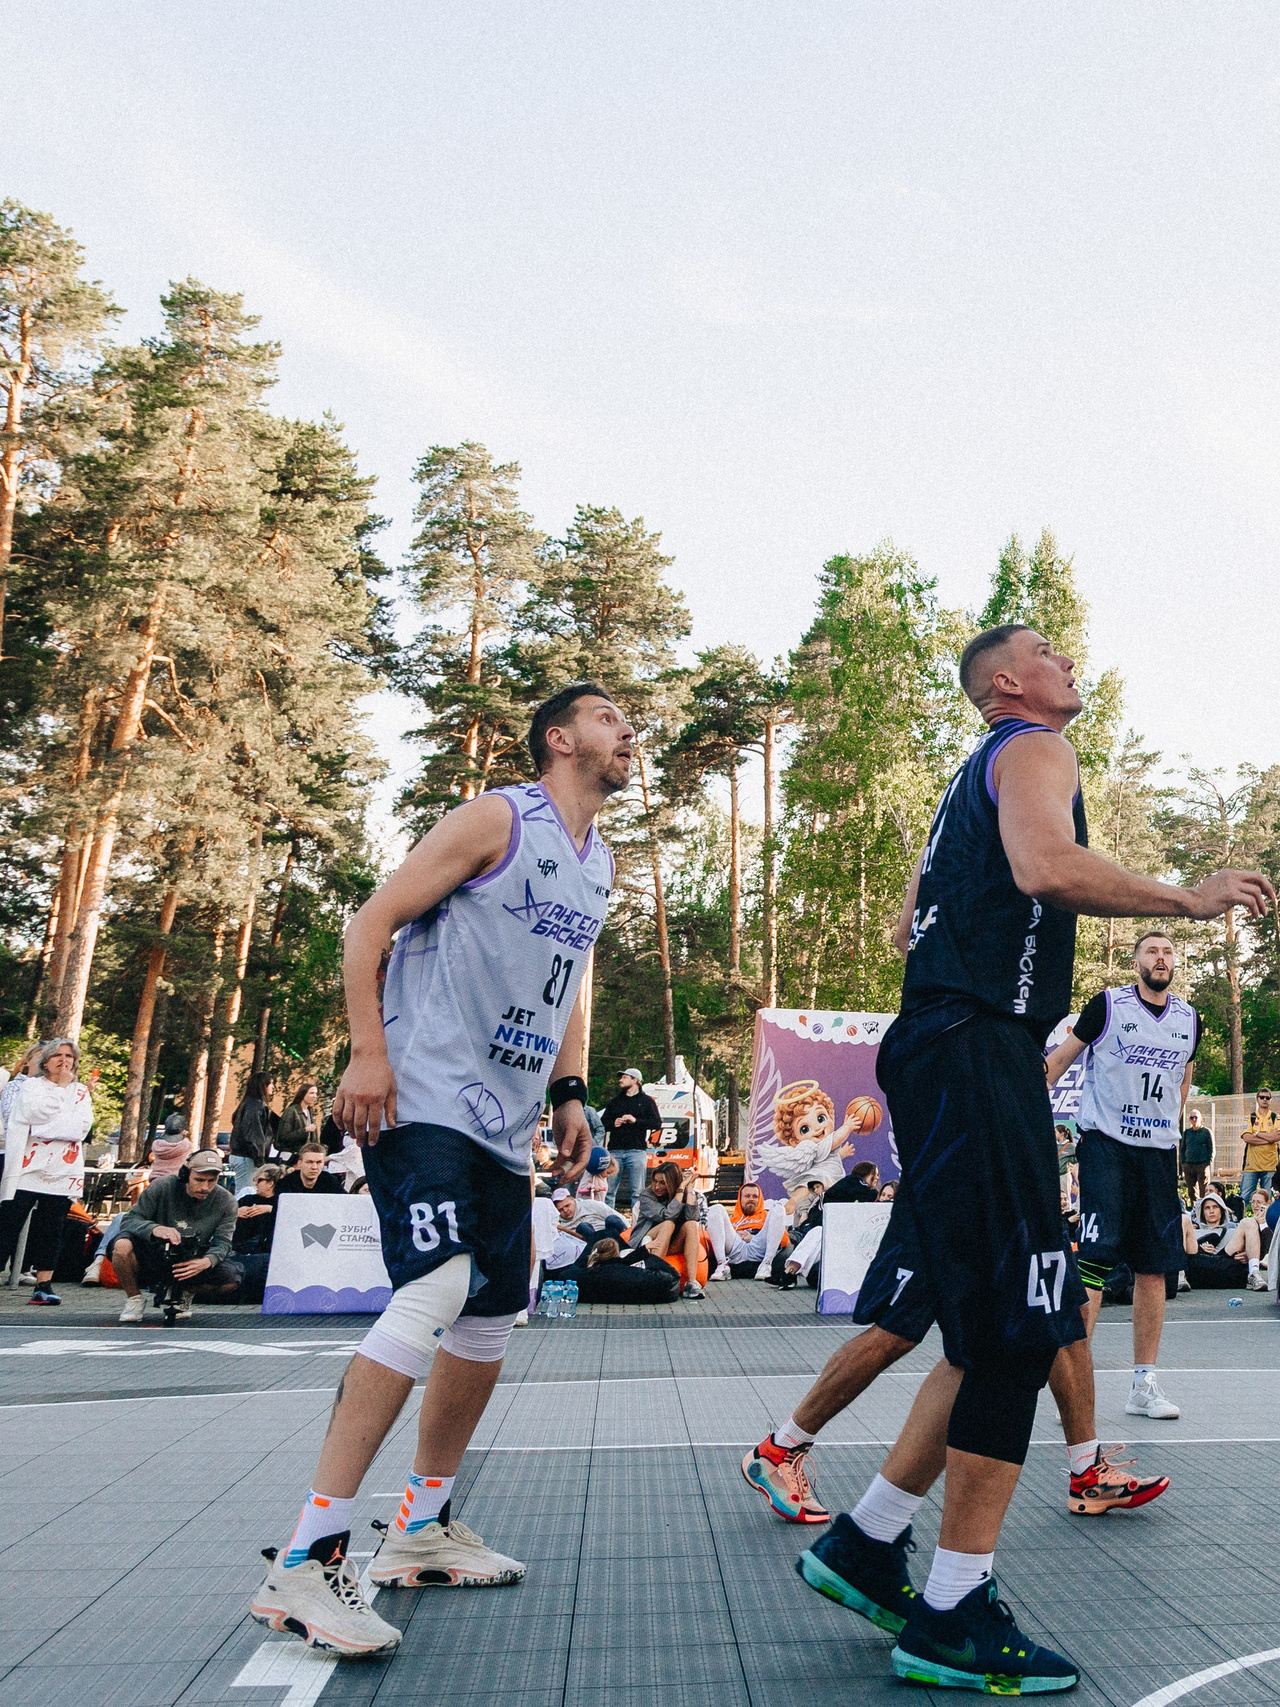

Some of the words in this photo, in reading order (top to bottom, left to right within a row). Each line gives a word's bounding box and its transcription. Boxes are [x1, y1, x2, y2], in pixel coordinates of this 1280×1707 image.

[542, 954, 574, 1008] 81
[502, 1006, 536, 1026] JET
[488, 1043, 543, 1073] TEAM
[1141, 1072, 1163, 1102] 14
[1121, 1104, 1139, 1114] JET
[1120, 1126, 1151, 1138] TEAM
[409, 1201, 461, 1251] 81
[1080, 1213, 1099, 1243] 14
[1027, 1250, 1066, 1314] 47
